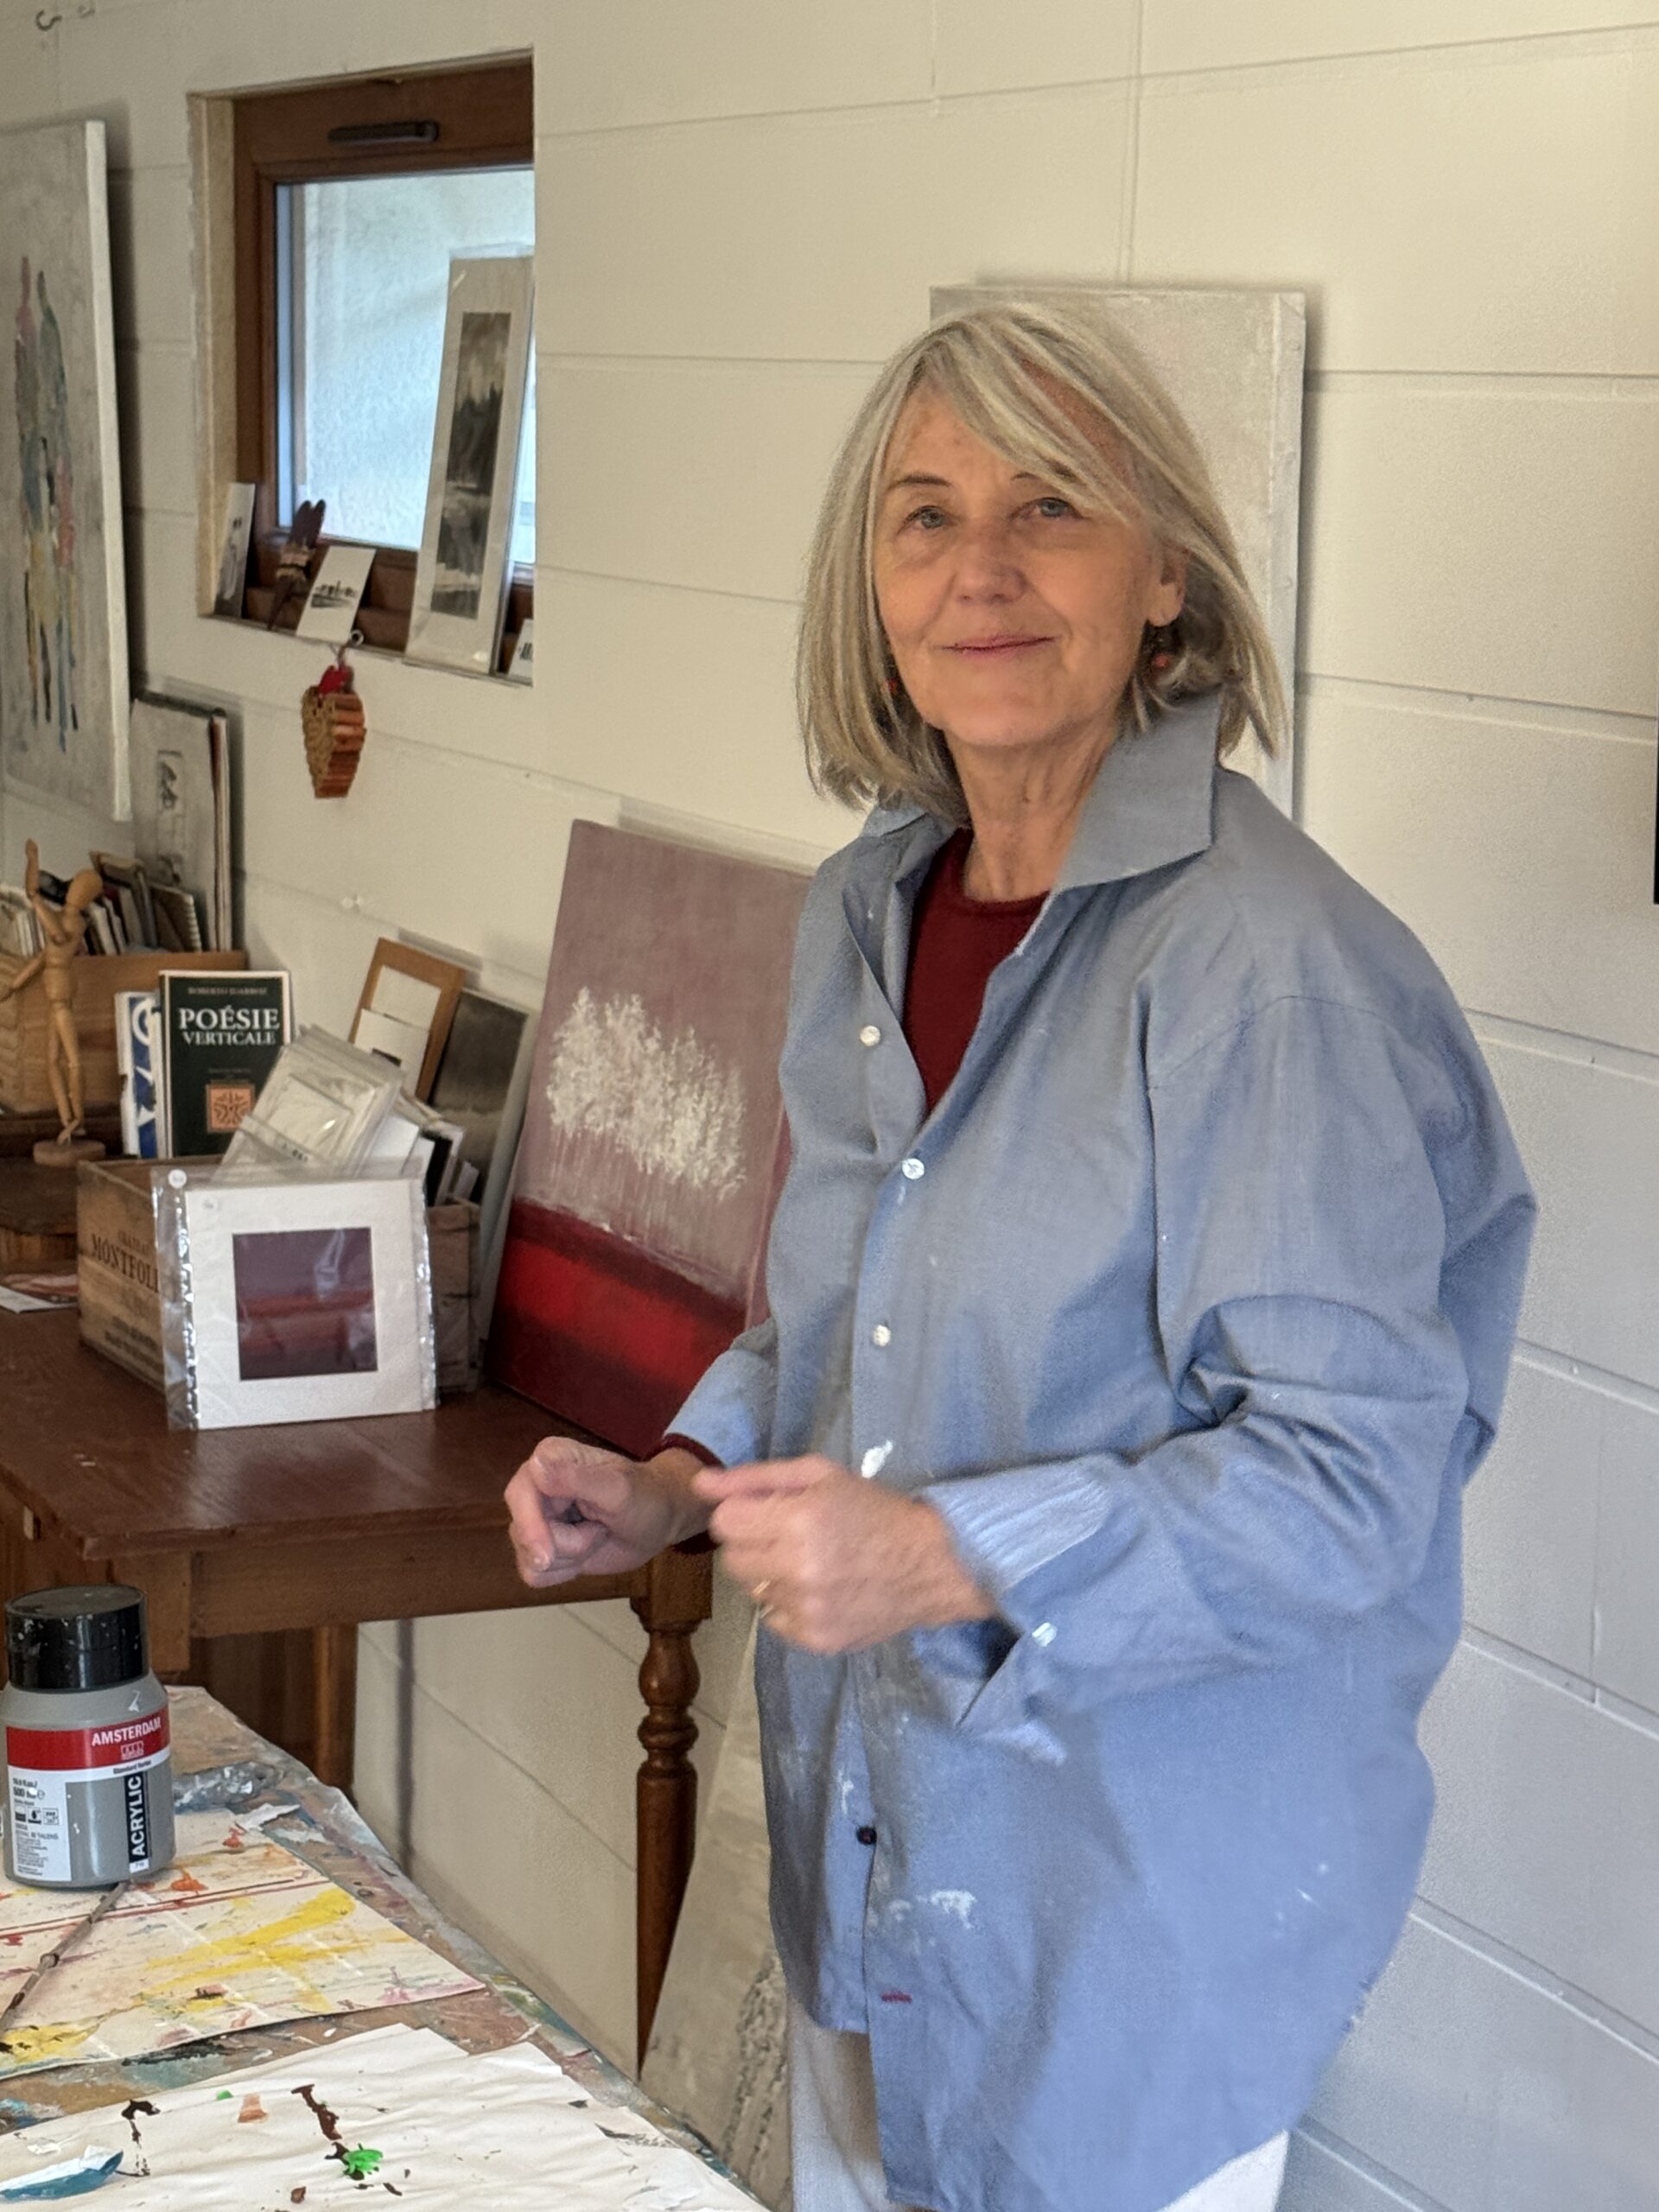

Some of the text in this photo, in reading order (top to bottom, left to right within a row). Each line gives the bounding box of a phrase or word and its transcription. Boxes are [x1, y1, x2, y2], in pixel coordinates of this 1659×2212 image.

[179, 1004, 280, 1030] POÉSIE
[182, 1031, 276, 1046] VERTICALE
[92, 1717, 162, 1746] AMSTERDAM
[128, 1776, 145, 1856] ACRYLIC
